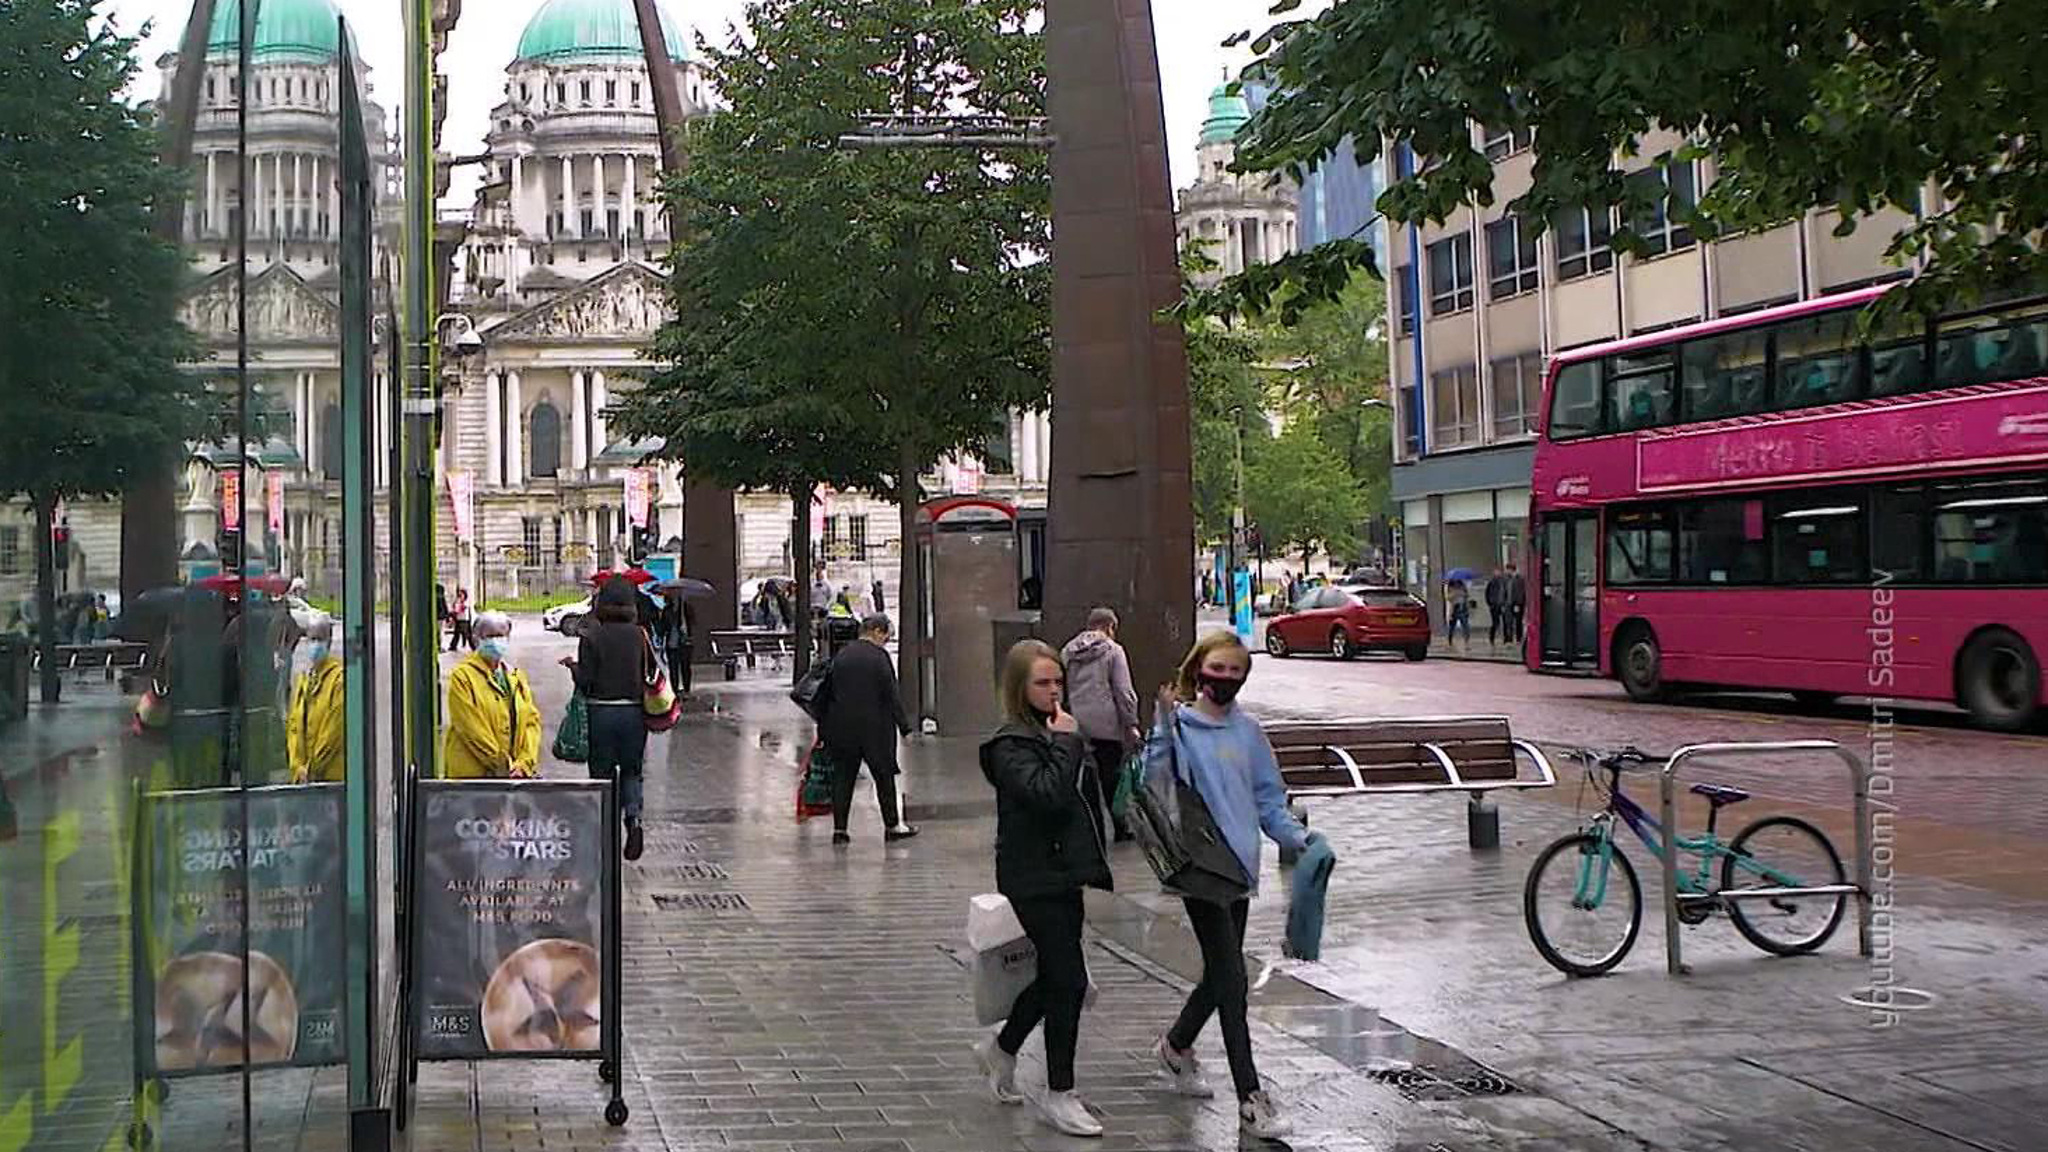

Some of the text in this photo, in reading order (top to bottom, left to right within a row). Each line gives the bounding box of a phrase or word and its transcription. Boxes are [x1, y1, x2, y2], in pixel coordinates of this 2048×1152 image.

[454, 817, 572, 840] COOKING
[495, 840, 572, 860] STARS
[430, 1015, 470, 1032] M&S
